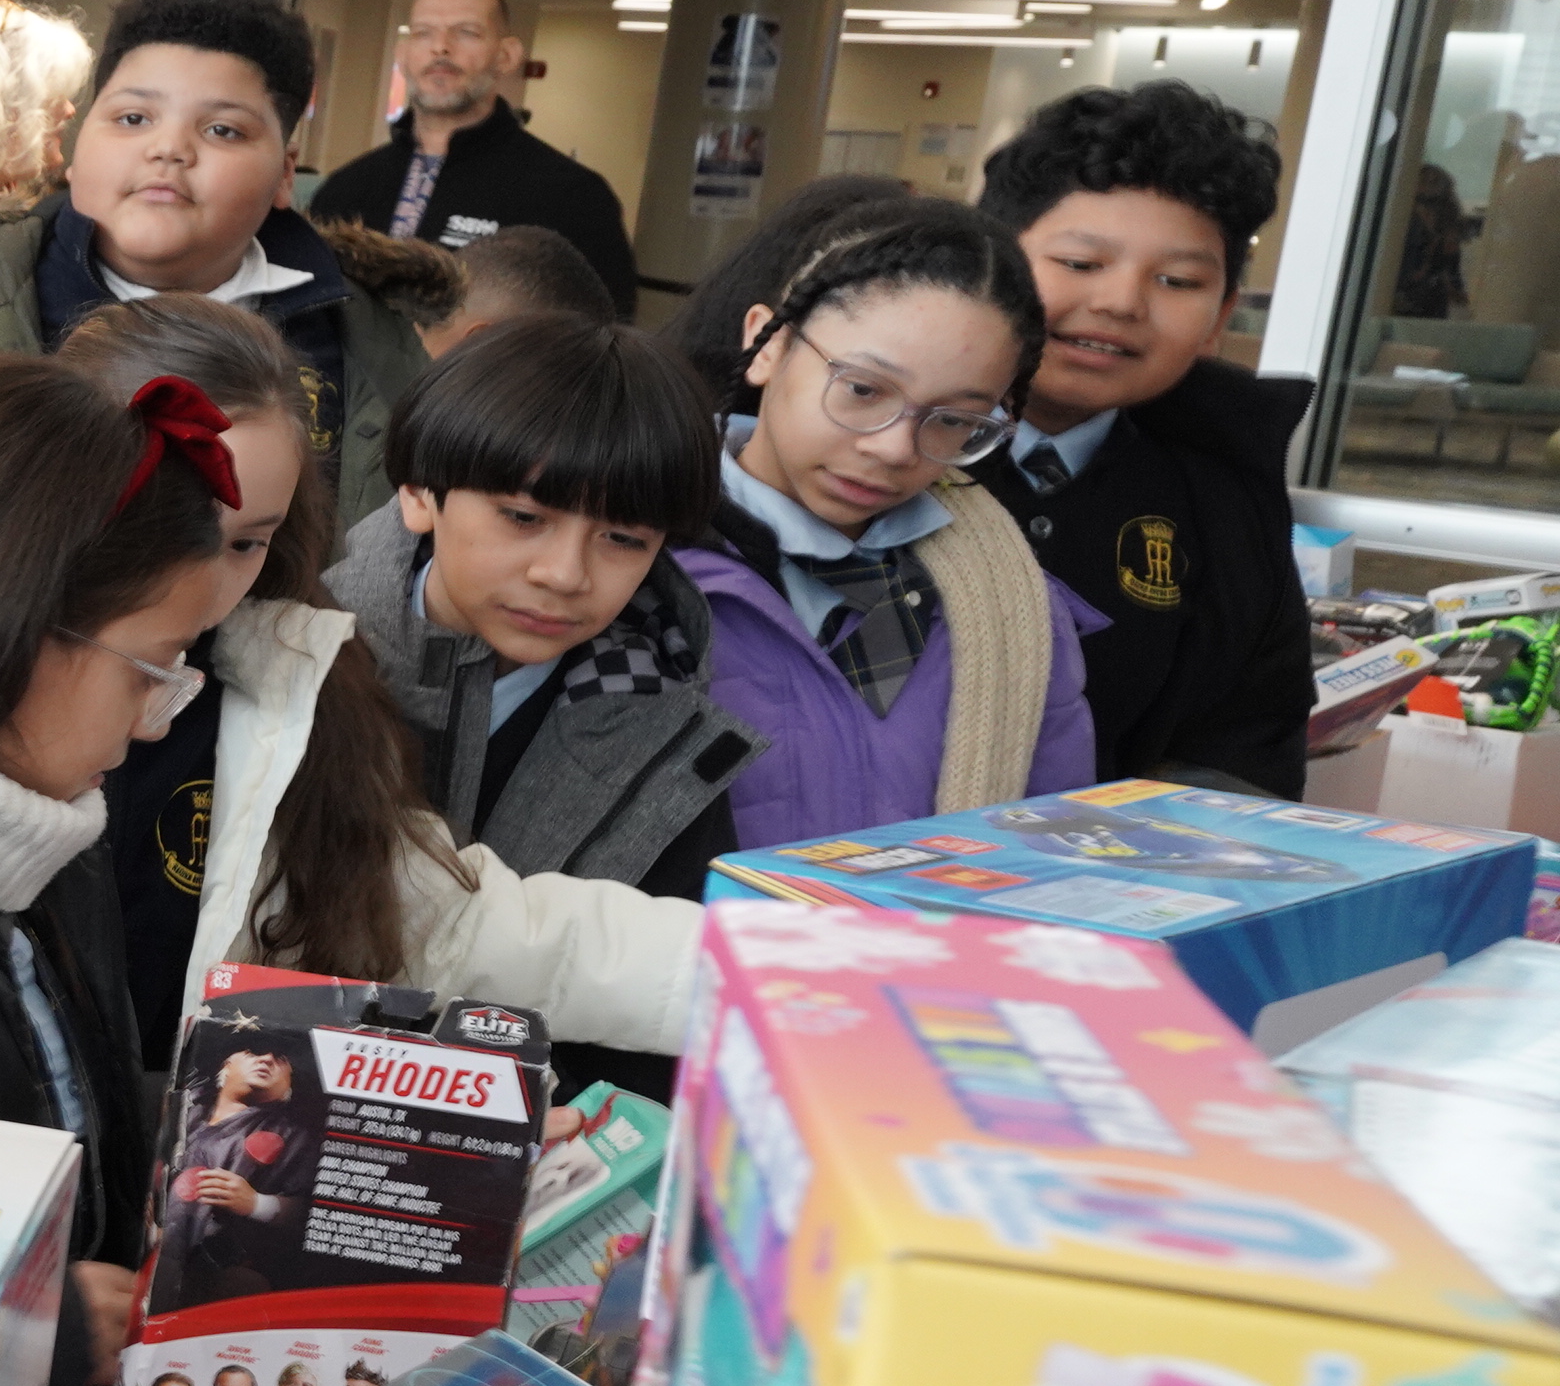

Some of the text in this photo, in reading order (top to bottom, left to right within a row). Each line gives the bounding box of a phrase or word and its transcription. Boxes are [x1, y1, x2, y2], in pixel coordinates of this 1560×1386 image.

[210, 970, 232, 990] 83
[462, 1013, 528, 1035] ELITE
[344, 1040, 409, 1057] DUSTY
[336, 1053, 497, 1108] RHODES
